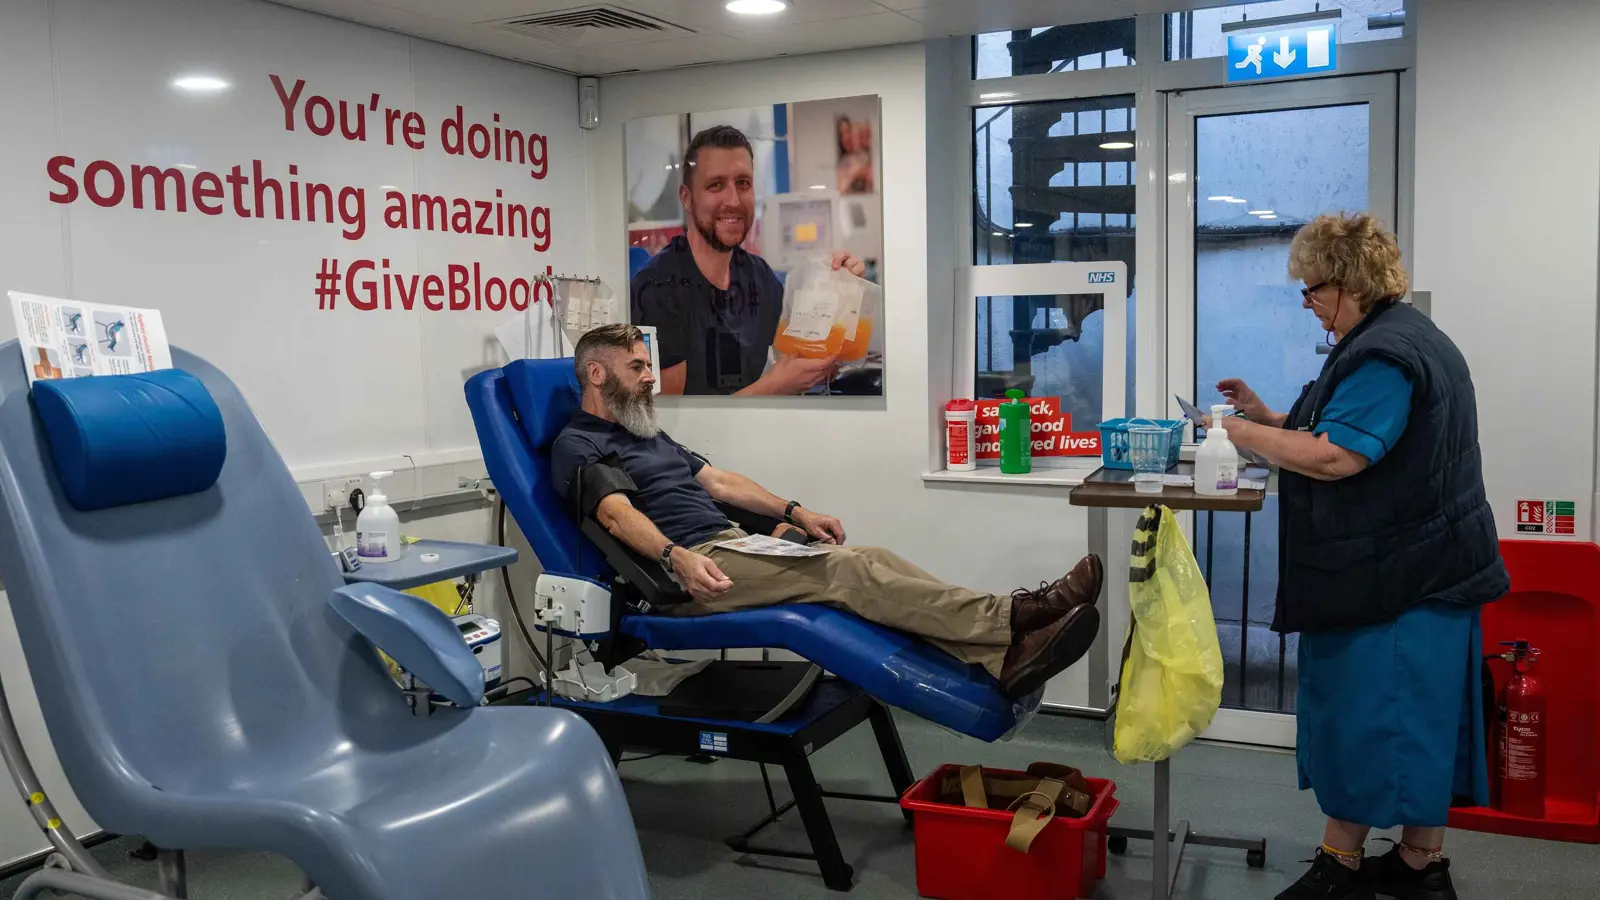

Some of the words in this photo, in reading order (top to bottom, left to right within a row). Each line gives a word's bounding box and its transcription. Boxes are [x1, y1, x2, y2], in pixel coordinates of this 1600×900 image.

[269, 74, 426, 150] You're
[441, 105, 549, 179] doing
[47, 155, 366, 240] something
[384, 189, 552, 252] amazing
[1089, 272, 1114, 283] NHS
[982, 406, 1000, 417] sa
[974, 424, 1000, 439] gav
[1030, 418, 1063, 432] ood
[1059, 437, 1098, 450] lives
